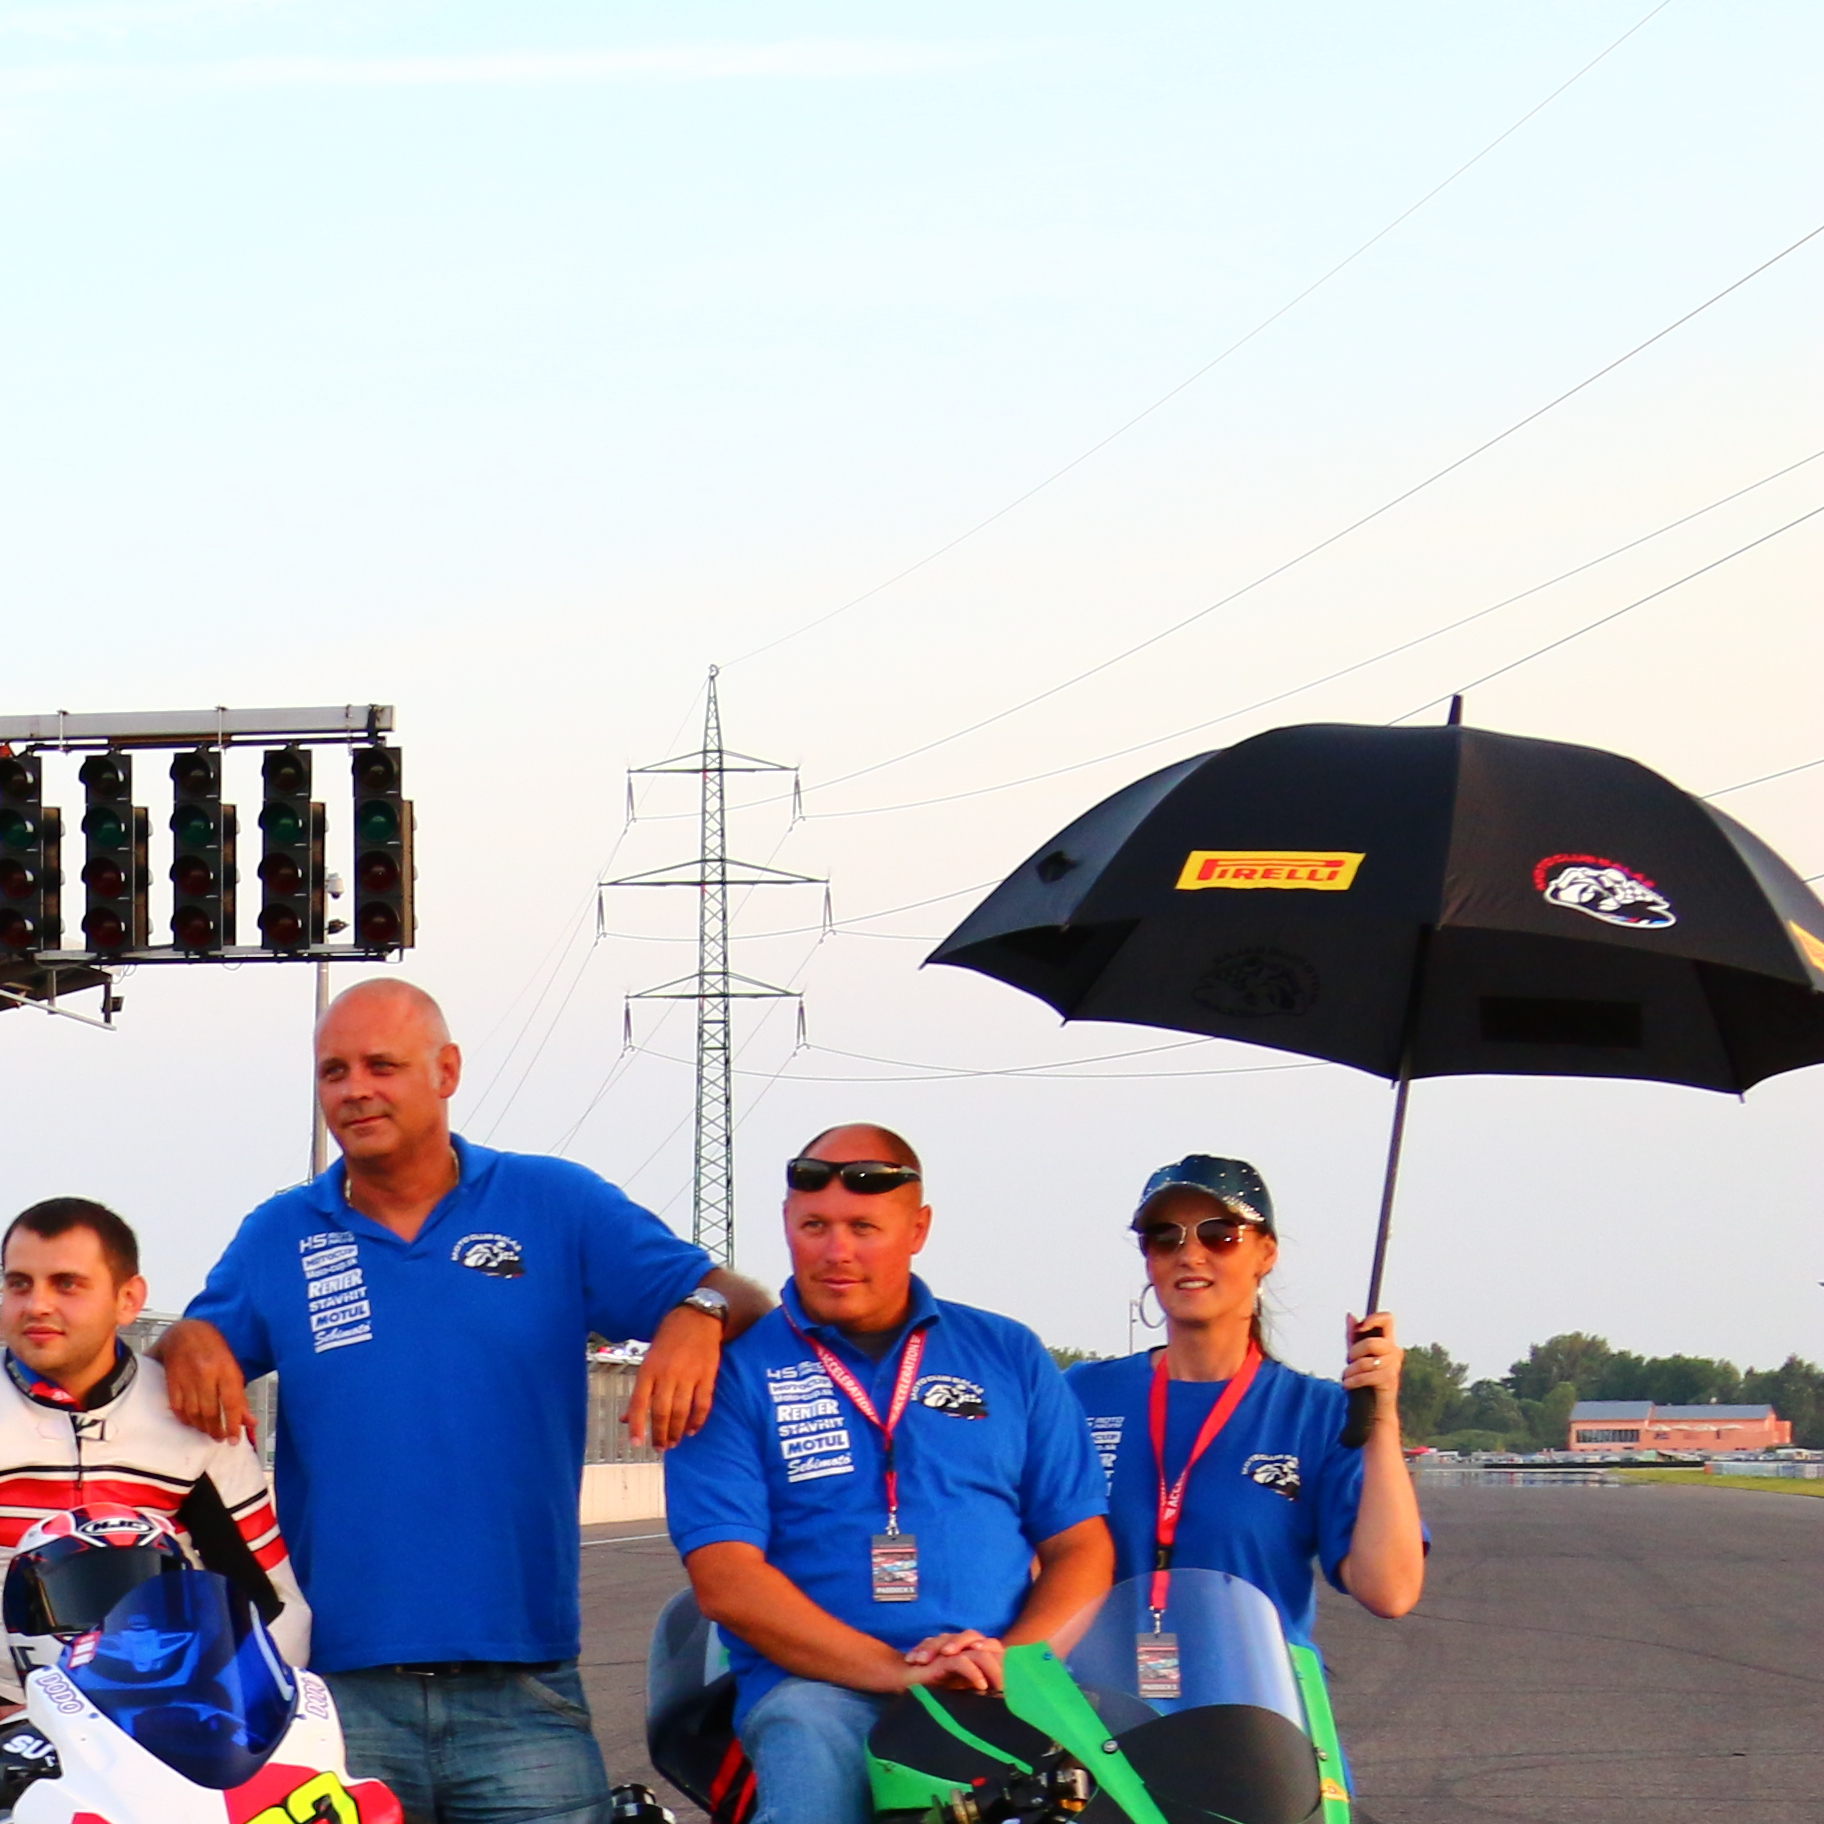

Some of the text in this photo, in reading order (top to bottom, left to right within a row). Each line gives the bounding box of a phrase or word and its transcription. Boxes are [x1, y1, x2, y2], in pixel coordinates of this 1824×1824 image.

[1197, 858, 1345, 881] PIRELLI
[299, 1233, 328, 1253] HS
[308, 1268, 364, 1299] RENTER
[309, 1286, 367, 1312] STAVHIT
[315, 1305, 366, 1329] MOTUL
[821, 1353, 875, 1417] ACCELERATION
[893, 1343, 920, 1414] ACCELERATION
[776, 1399, 840, 1423] RENTER
[778, 1417, 845, 1437] STAVHIT
[787, 1434, 845, 1454] MOTUL
[787, 1452, 852, 1475] Sebimoto
[93, 1518, 143, 1531] HJC
[36, 1673, 85, 1715] DODO
[302, 1675, 330, 1720] DODO
